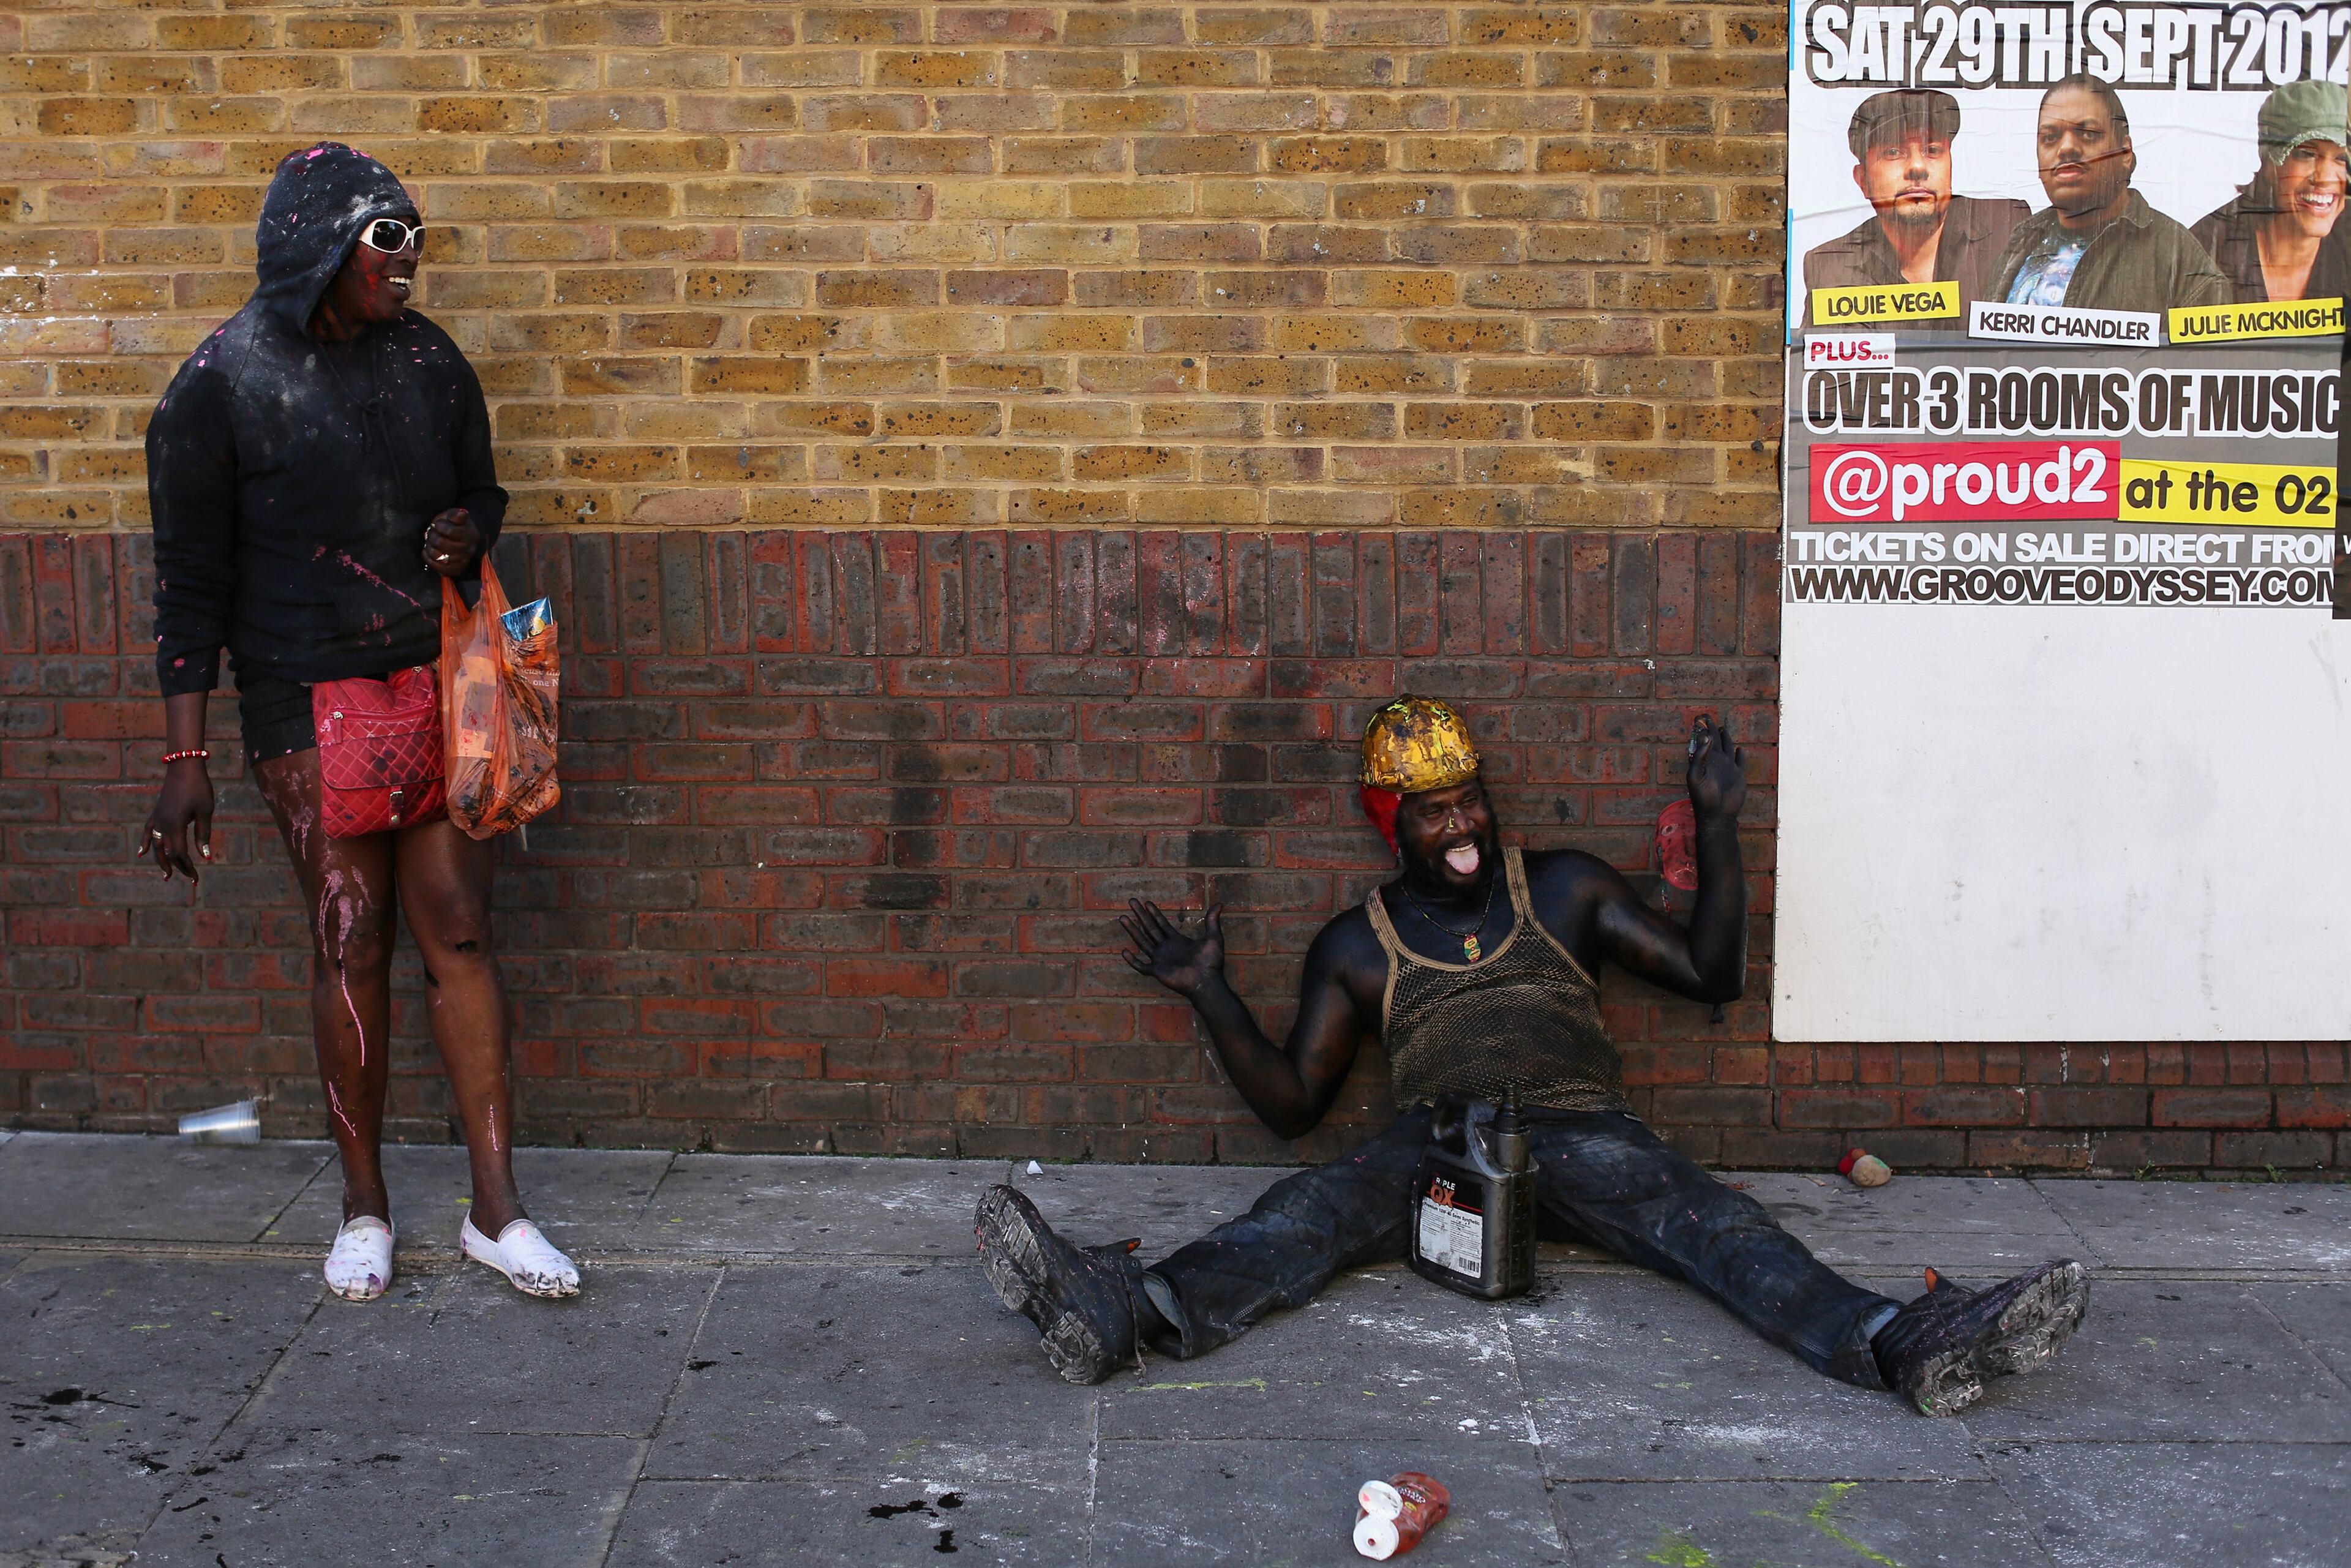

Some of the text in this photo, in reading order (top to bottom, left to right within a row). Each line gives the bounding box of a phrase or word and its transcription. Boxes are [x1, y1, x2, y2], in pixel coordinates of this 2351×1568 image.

[1812, 5, 1914, 81] SAT
[1922, 5, 2066, 83] 29TH
[2088, 7, 2223, 84] SEPT
[1828, 291, 1946, 317] LOUIE VEGA
[1980, 311, 2150, 341] KERRI CHANDLER
[2179, 307, 2344, 337] JULIE MCKNIGHT
[1810, 340, 1889, 362] PLUS...
[1807, 371, 2341, 433] OVER 3 ROOMS OF MUSIC
[1823, 445, 2107, 522] @proud2
[2126, 470, 2173, 509] at
[2186, 469, 2259, 512] the
[1790, 531, 1946, 563] TICKETS
[1952, 531, 2007, 563] ON
[2014, 532, 2107, 563] SALE
[2113, 533, 2246, 564] DIRECT
